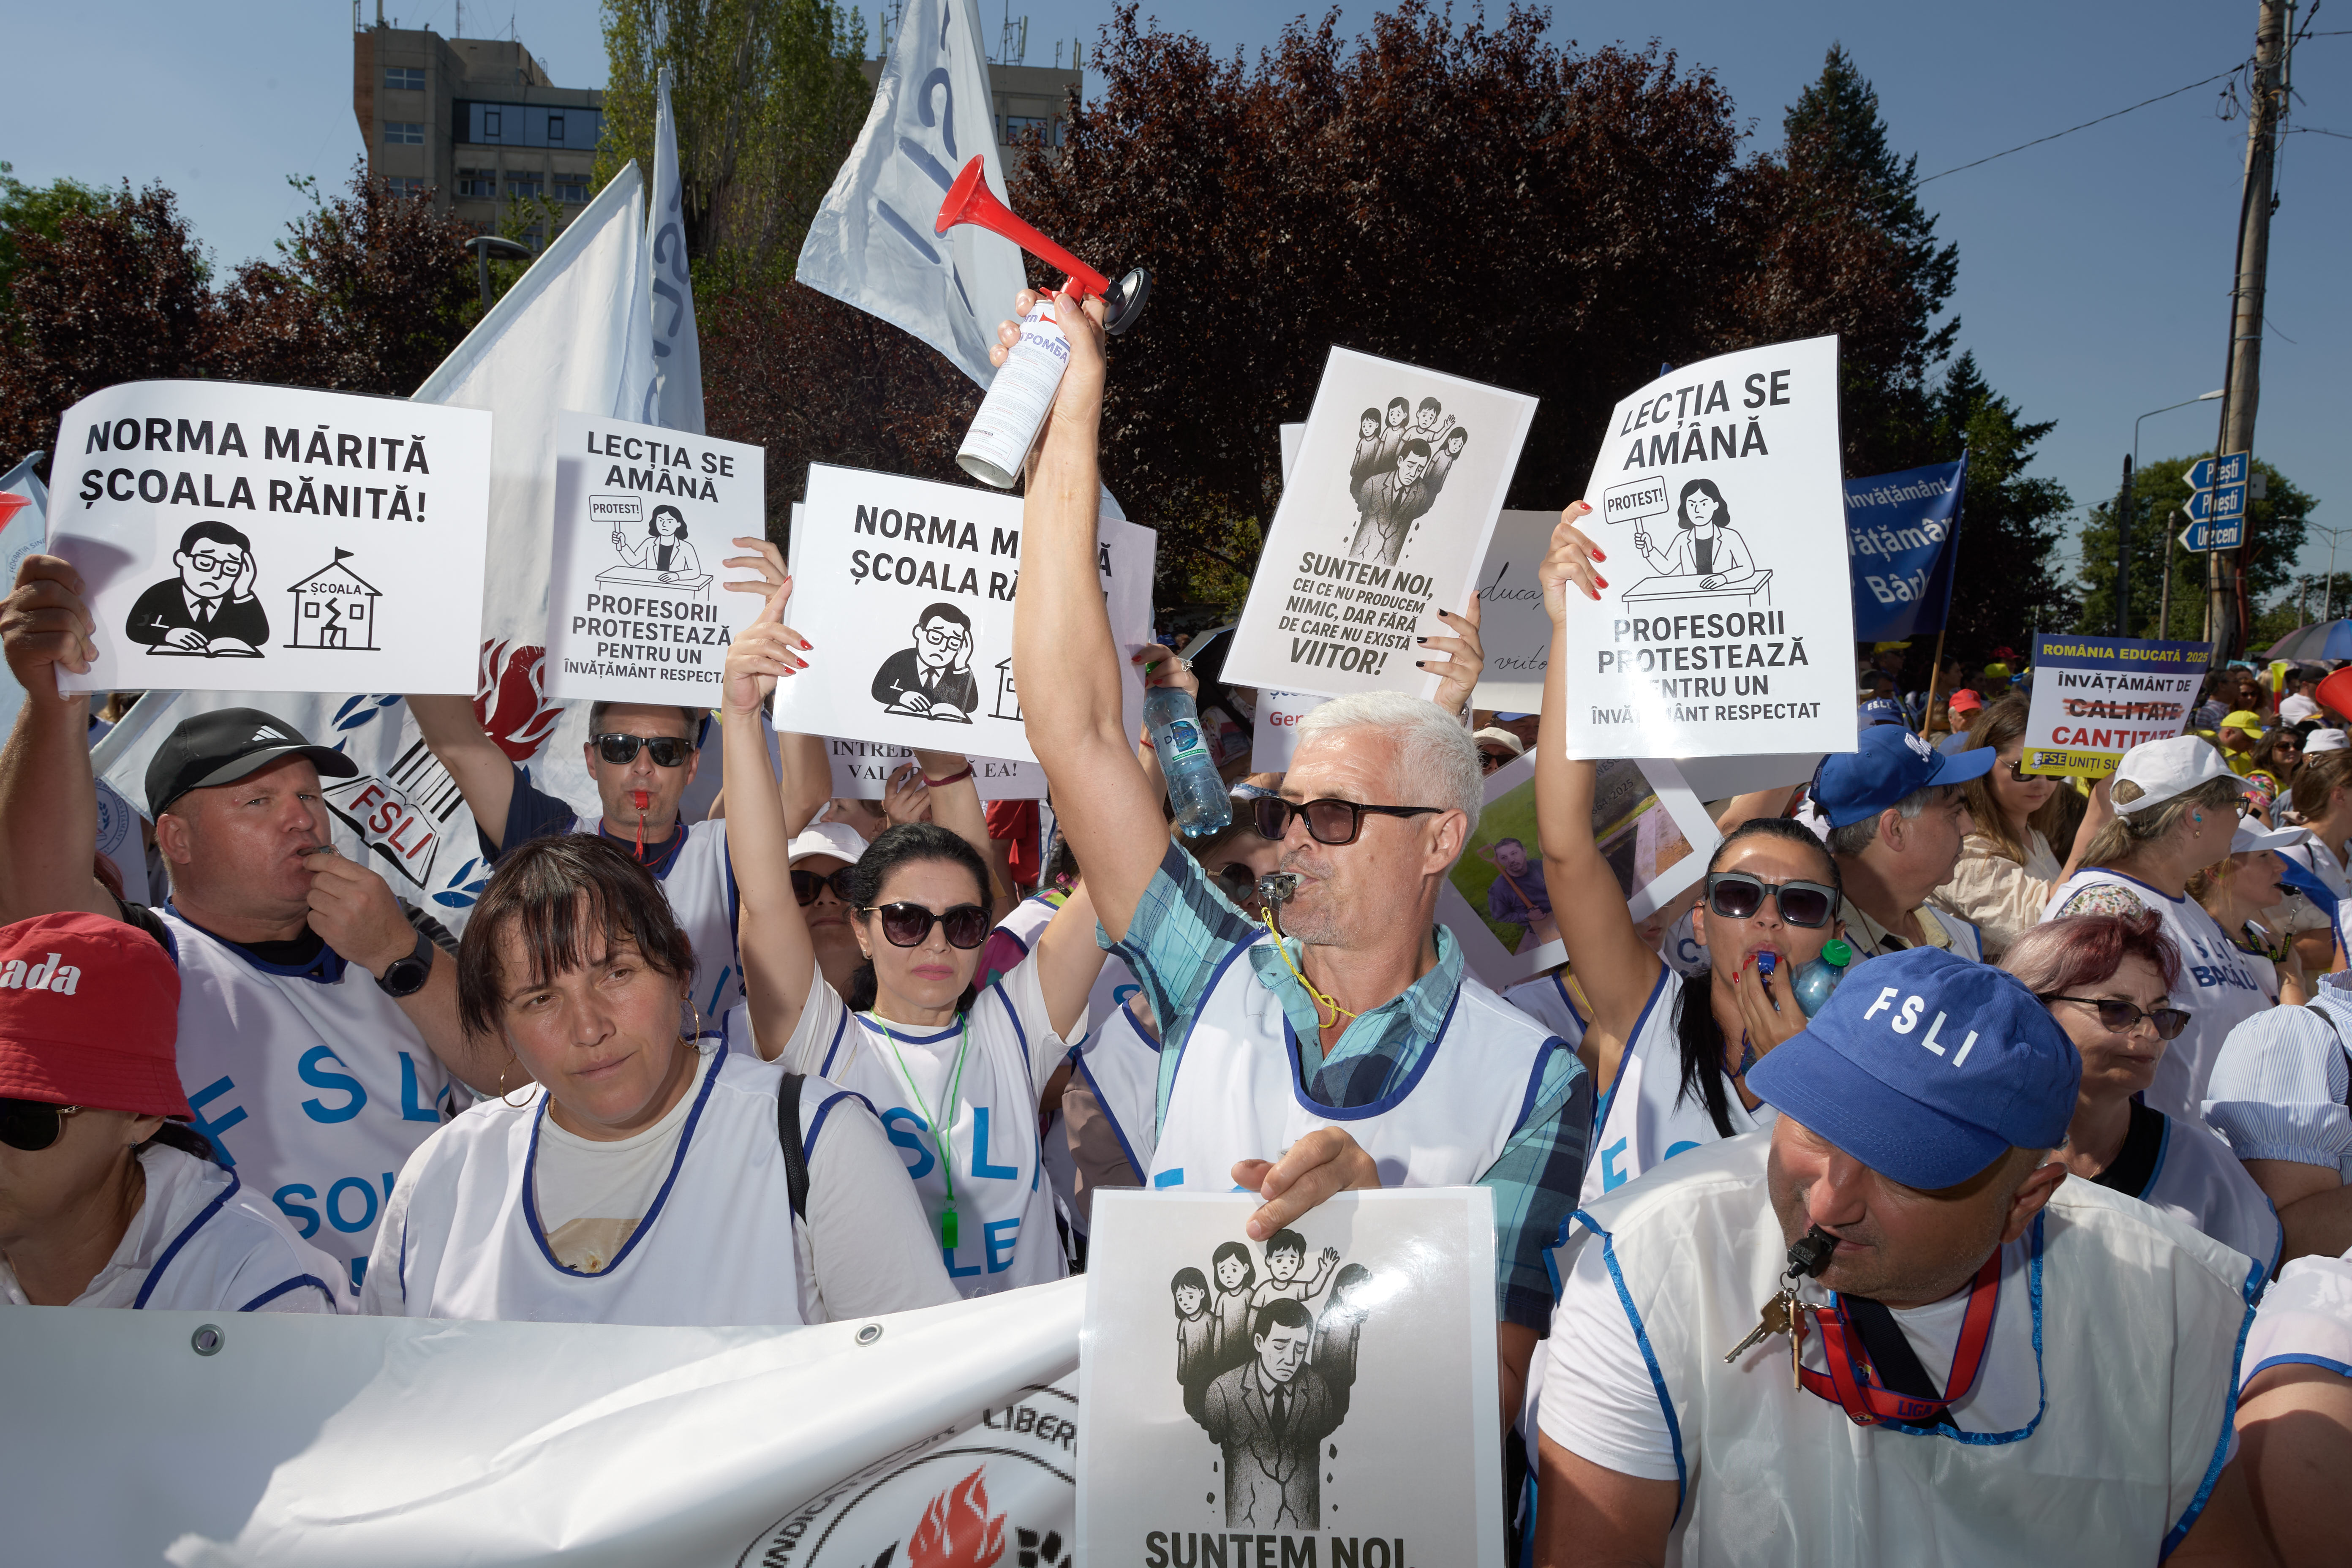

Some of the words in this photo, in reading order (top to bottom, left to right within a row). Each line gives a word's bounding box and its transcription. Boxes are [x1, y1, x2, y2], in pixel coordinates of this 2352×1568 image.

[1620, 380, 1730, 438] LECȚIA
[1743, 369, 1790, 408] SE
[85, 418, 248, 457] NORMA
[264, 425, 430, 474] MĂRITĂ
[588, 431, 691, 471] LECȚIA
[702, 452, 734, 478] SE
[1622, 416, 1768, 471] AMÂNĂ
[604, 465, 719, 503] AMÂNĂ
[2206, 457, 2239, 483] Pești
[79, 468, 256, 509] ȘCOALA
[269, 476, 426, 523] RĂNITĂ!
[593, 504, 640, 514] PROTEST!
[1607, 488, 1663, 512] PROTEST!
[2202, 489, 2238, 514] Plești
[855, 504, 978, 552] NORMA
[310, 581, 362, 595] ȘCOALA
[850, 549, 979, 596] ȘCOALA
[1299, 552, 1391, 588] SUNTEM
[1392, 571, 1433, 600] NOI,
[587, 594, 717, 623] PROFESORII
[1293, 577, 1315, 593] CEI
[1316, 583, 1334, 596] CE
[1334, 586, 1355, 600] NU
[1356, 590, 1426, 614] PRODUCEM
[1286, 595, 1338, 622] NIMIC,
[1342, 606, 1376, 625] DAR
[1377, 612, 1418, 633] FĂRĂ
[1614, 610, 1784, 642] PROFESORII
[572, 616, 731, 646] PROTESTEAZĂ
[1278, 615, 1300, 632] DE
[1301, 620, 1339, 638] CARE
[1340, 626, 1363, 642] NU
[1363, 630, 1412, 651] EXISTĂ
[597, 642, 670, 662] PENTRU
[677, 648, 702, 664] UN
[1290, 637, 1388, 675] VIITOR!
[1598, 637, 1808, 673] PROTESTEAZĂ
[2043, 644, 2114, 659] ROMÂNIA
[2119, 649, 2180, 662] EDUCATĂ
[2186, 652, 2208, 663] 2025
[564, 659, 656, 679] ÎNVĂȚĂMÂNT
[660, 667, 725, 683] RESPECT
[1633, 675, 1726, 698] NTRU
[1735, 675, 1768, 696] UN
[2058, 671, 2174, 693] ÎNVĂȚĂMÂNT
[2176, 680, 2191, 691] DE
[1591, 702, 1709, 724] ÎNVĂÂNT
[1715, 702, 1821, 721] RESPECTAT
[2069, 699, 2180, 720] CALITATE
[984, 762, 1017, 777] EA!
[2041, 753, 2066, 765] FSE
[2069, 756, 2102, 772] UNIȚI
[1592, 779, 1633, 814] 864-2025
[348, 784, 433, 859] FSLI
[2190, 964, 2258, 991] BACĂU
[1864, 986, 1979, 1067] FSLI
[1897, 1400, 1932, 1416] LIGA
[983, 1404, 1076, 1451] LIBER
[1146, 1531, 1317, 1568] SUNTEM
[1331, 1537, 1409, 1568] NOI
